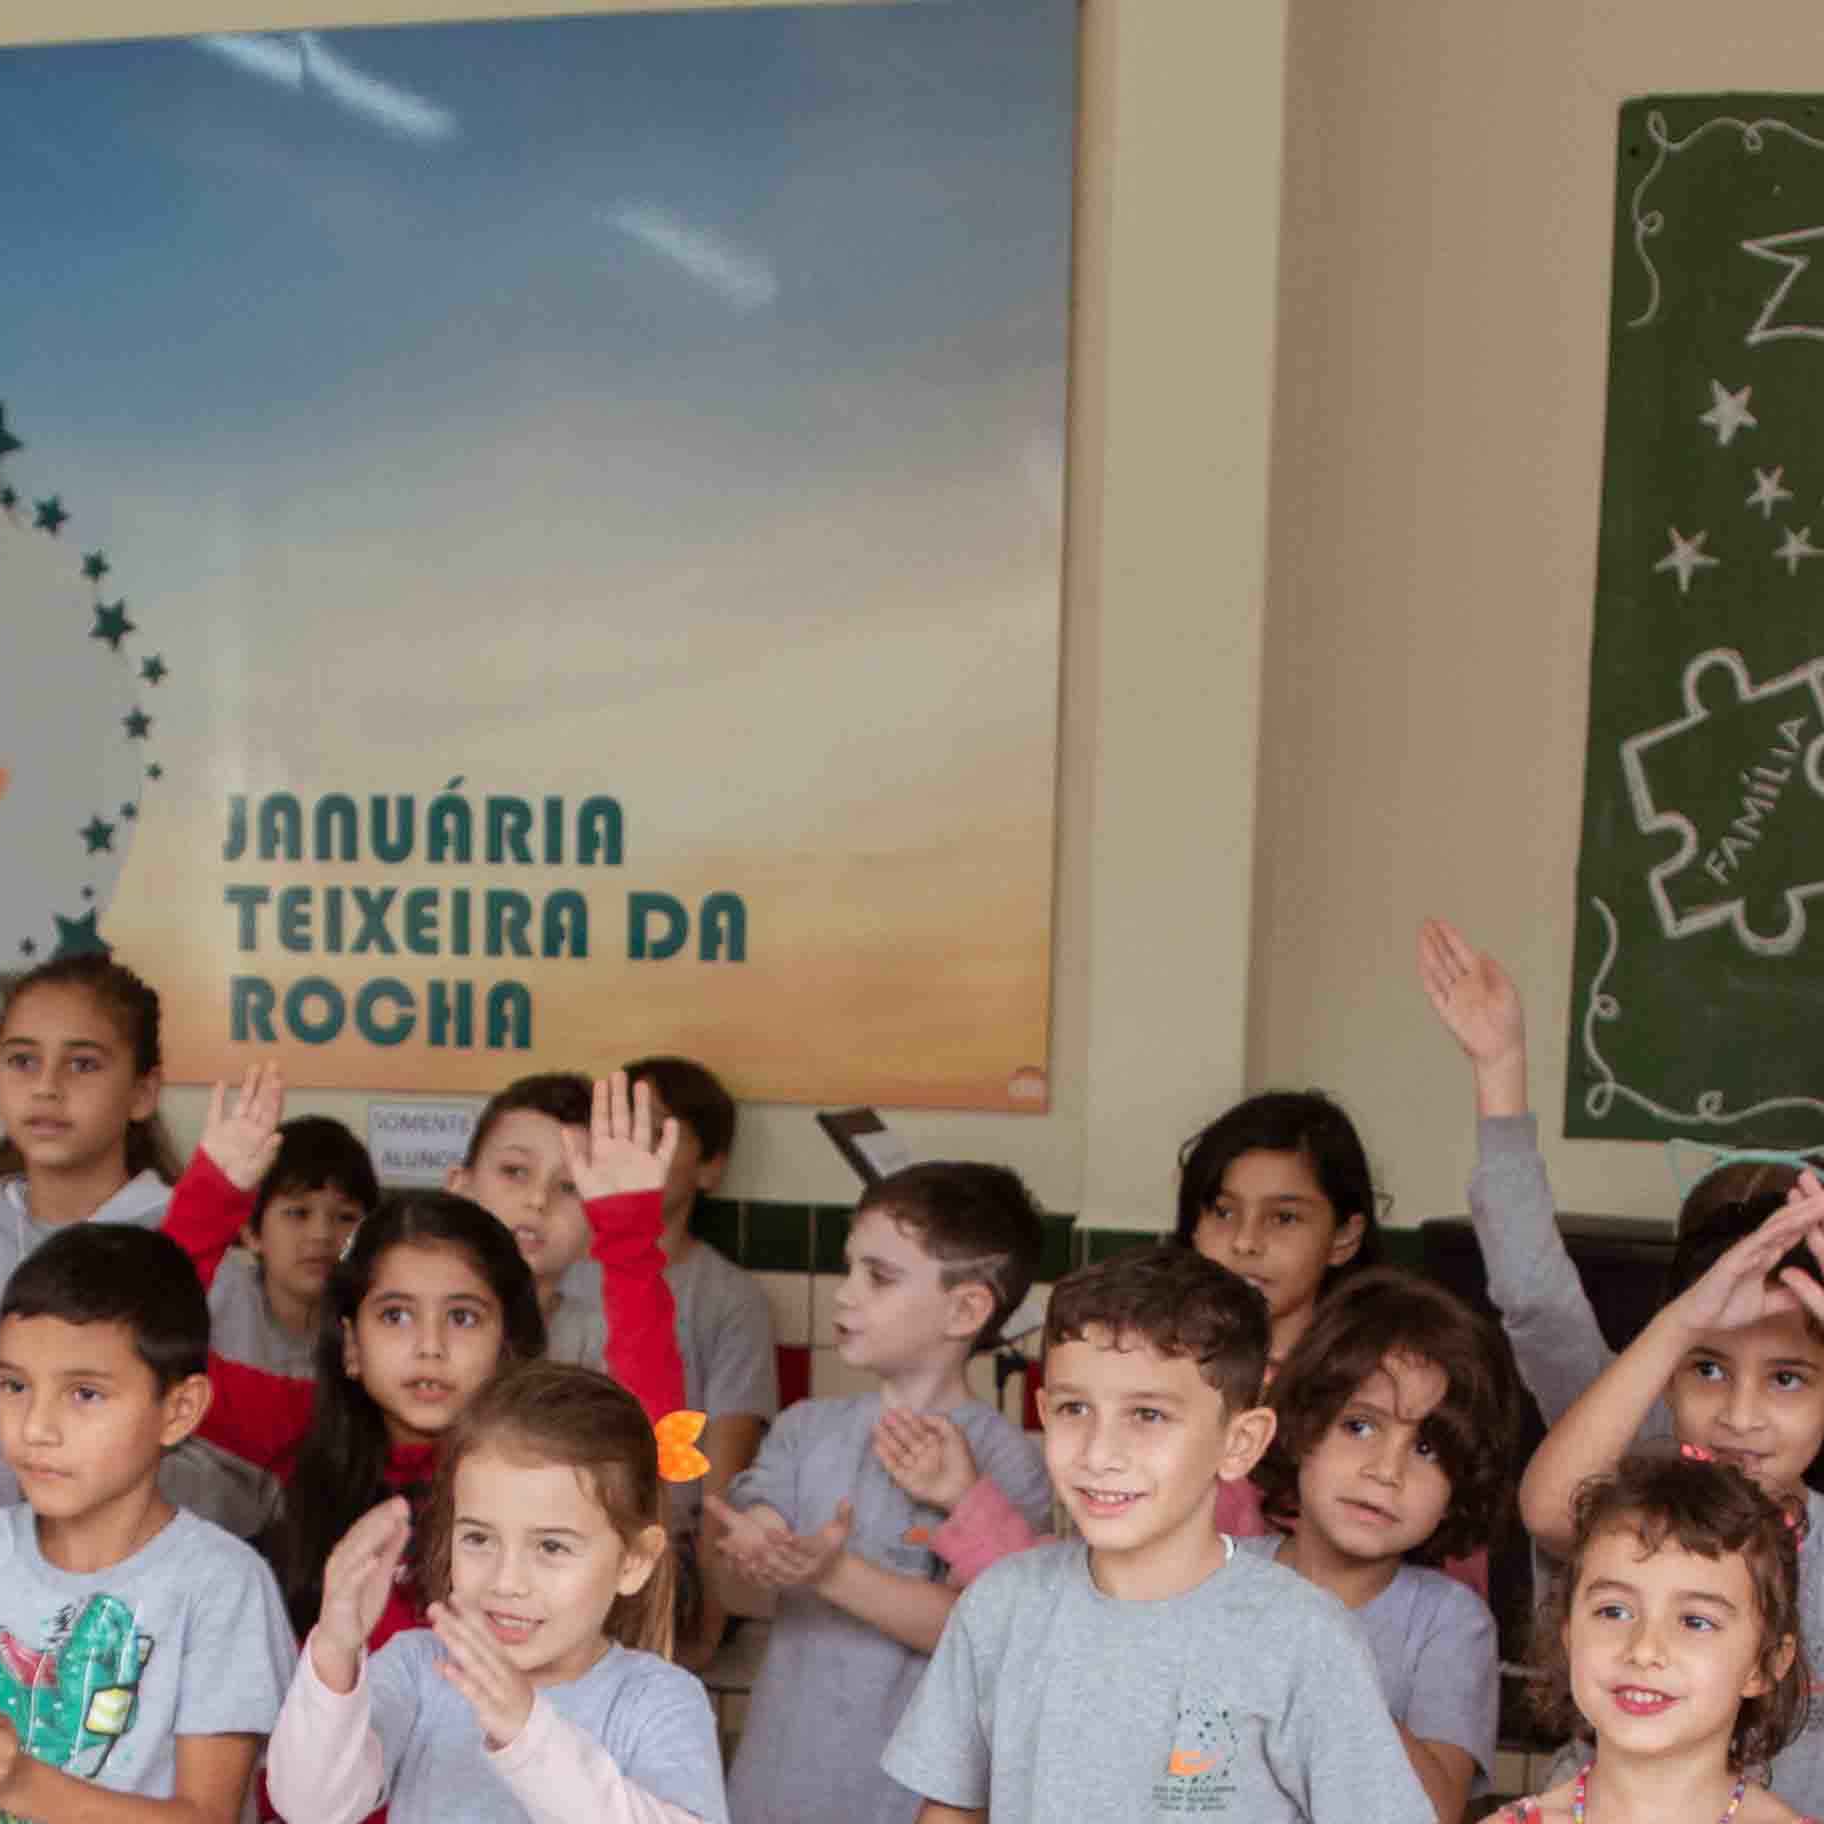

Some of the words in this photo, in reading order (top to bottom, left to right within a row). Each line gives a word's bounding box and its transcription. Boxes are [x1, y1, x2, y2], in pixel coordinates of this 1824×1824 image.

[222, 775, 624, 867] JANUÁRIA
[1703, 714, 1810, 886] FAMÍLIA
[223, 884, 590, 959] TEIXEIRA
[625, 891, 748, 962] DA
[229, 975, 534, 1050] ROCHA
